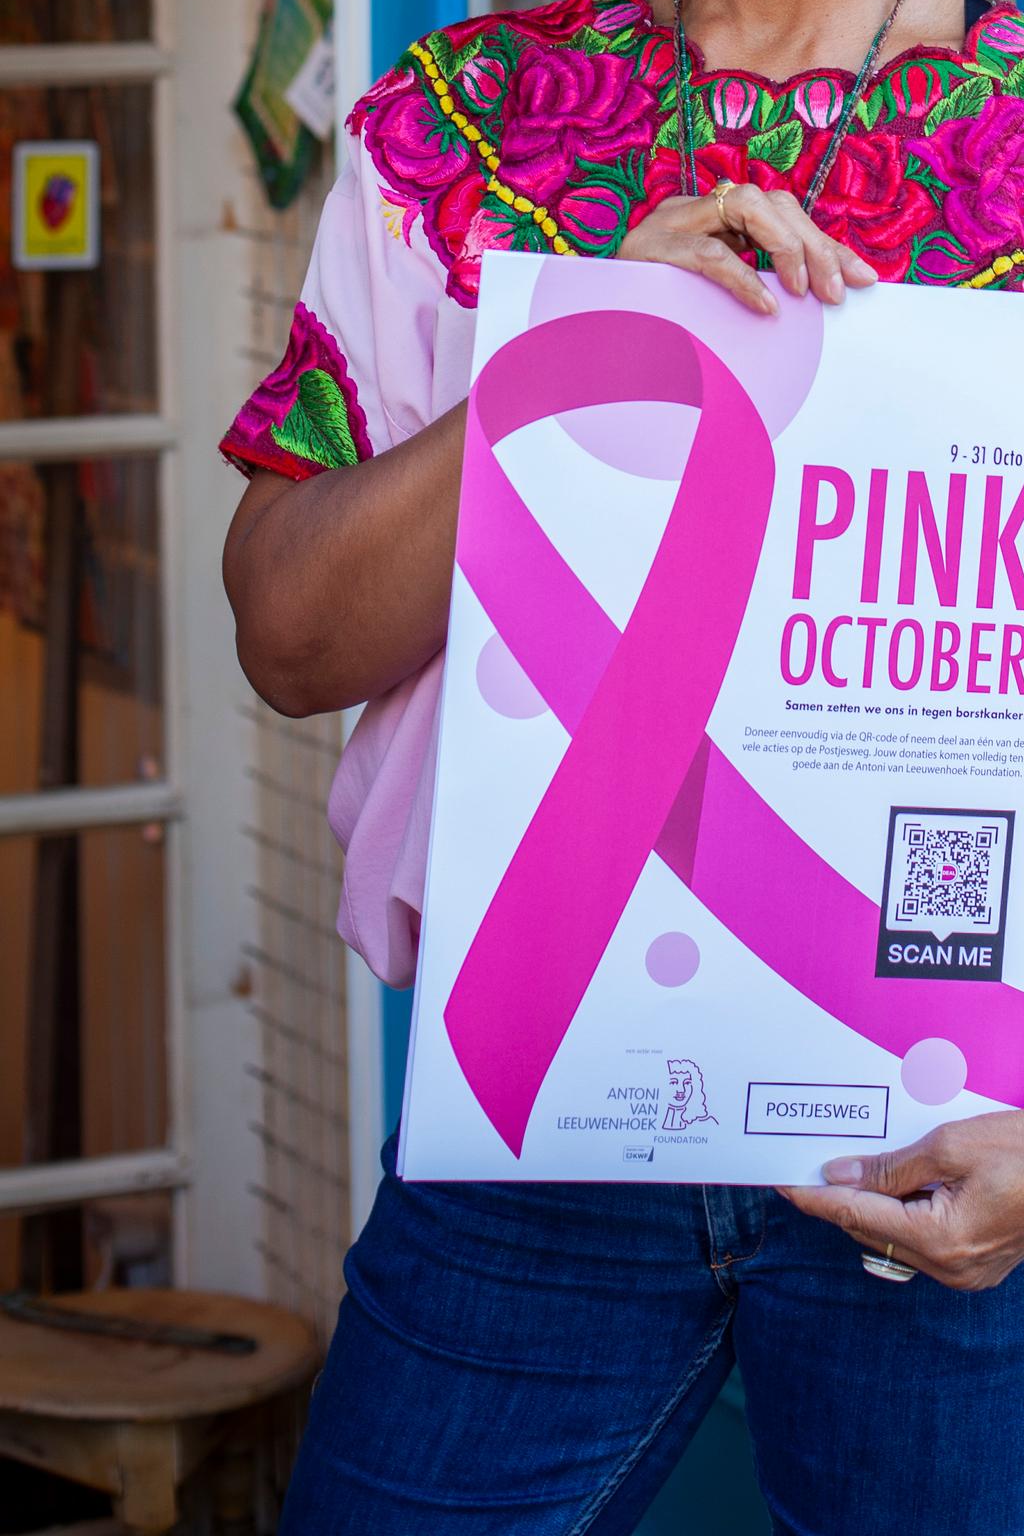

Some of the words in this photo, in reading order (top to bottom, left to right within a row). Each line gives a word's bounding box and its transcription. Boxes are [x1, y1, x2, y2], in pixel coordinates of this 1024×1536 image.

[950, 444, 959, 463] 9
[971, 445, 986, 464] 31
[785, 699, 823, 712] Samen
[826, 703, 861, 714] zetten
[864, 705, 882, 715] we
[884, 706, 904, 716] ons
[908, 705, 918, 716] in
[921, 707, 952, 720] tegen
[744, 726, 779, 738] Doneer
[780, 729, 829, 742] eenvoudig
[830, 731, 844, 741] via
[845, 731, 858, 741] de
[859, 731, 898, 743] QR-code
[899, 733, 910, 743] of
[910, 735, 936, 744] neem
[938, 734, 958, 745] deel
[959, 737, 975, 746] aan
[977, 736, 994, 748] één
[995, 739, 1012, 748] van
[742, 742, 761, 752] vele
[763, 743, 789, 753] acties
[790, 745, 804, 755] op
[805, 744, 817, 755] de
[819, 745, 872, 759] Postjesweg.
[873, 747, 898, 758] Jouw
[899, 748, 938, 759] donaties
[939, 748, 970, 761] komen
[971, 751, 1007, 764] volledig
[1009, 753, 1024, 763] ten
[792, 760, 821, 771] goede
[823, 763, 840, 771] aan
[841, 761, 854, 771] de
[855, 762, 886, 772] Antoni
[888, 765, 904, 774] van
[905, 764, 968, 776] Leeuwenhoek
[969, 766, 1023, 778] Foundation.
[888, 944, 953, 965] SCAN
[958, 946, 993, 967] ME
[606, 1087, 660, 1100] ANTONI
[630, 1103, 658, 1115] VAN
[766, 1102, 870, 1120] POSTJESWEG
[557, 1116, 657, 1131] LEEUWENHOEK
[653, 1135, 708, 1144] FOUNDATION
